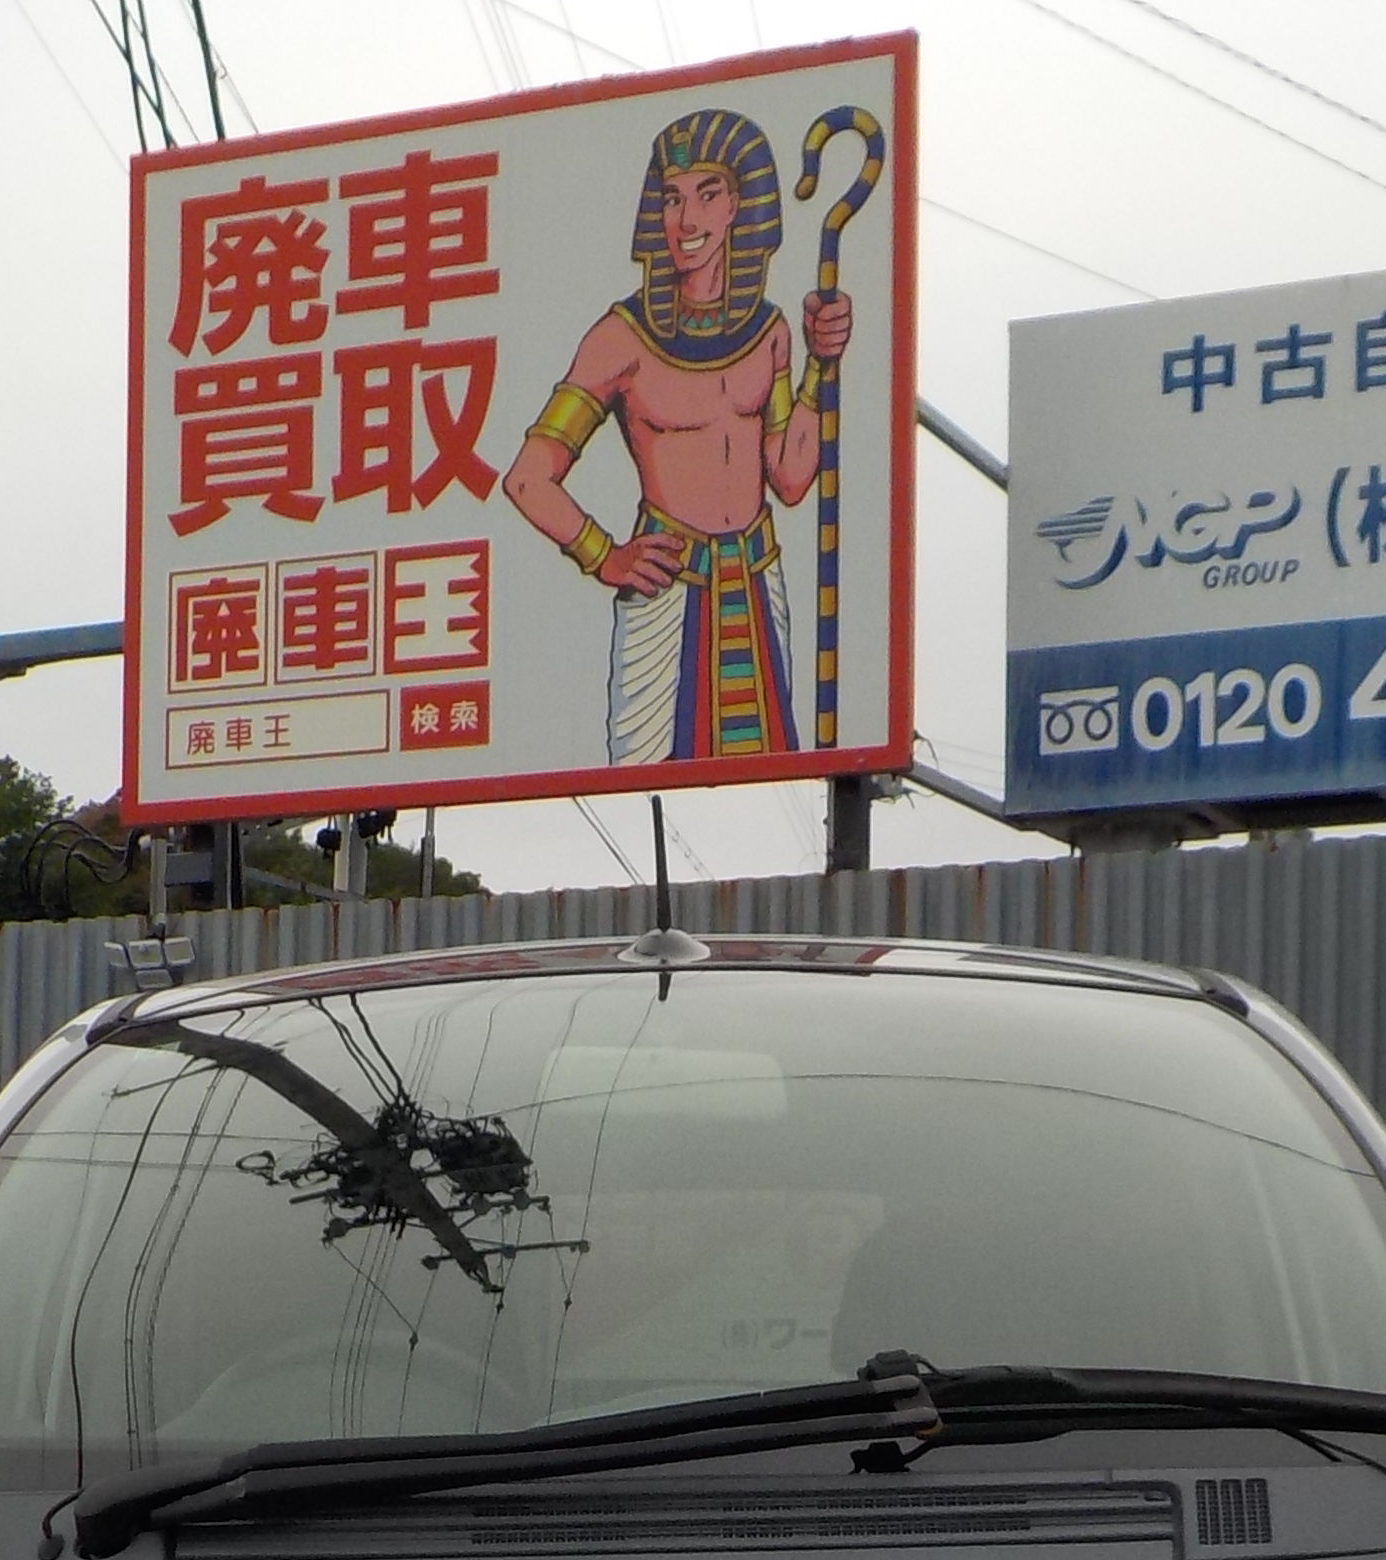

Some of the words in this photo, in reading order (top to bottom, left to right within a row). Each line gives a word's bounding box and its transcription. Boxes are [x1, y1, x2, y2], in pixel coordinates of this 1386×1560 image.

[166, 149, 501, 358] 廃車
[166, 334, 500, 537] 買取
[169, 539, 490, 692] 廃車王
[1202, 558, 1300, 589] GROUP
[186, 713, 292, 756] 廃車王
[410, 700, 480, 735] 検索
[1131, 663, 1324, 749] 0120
